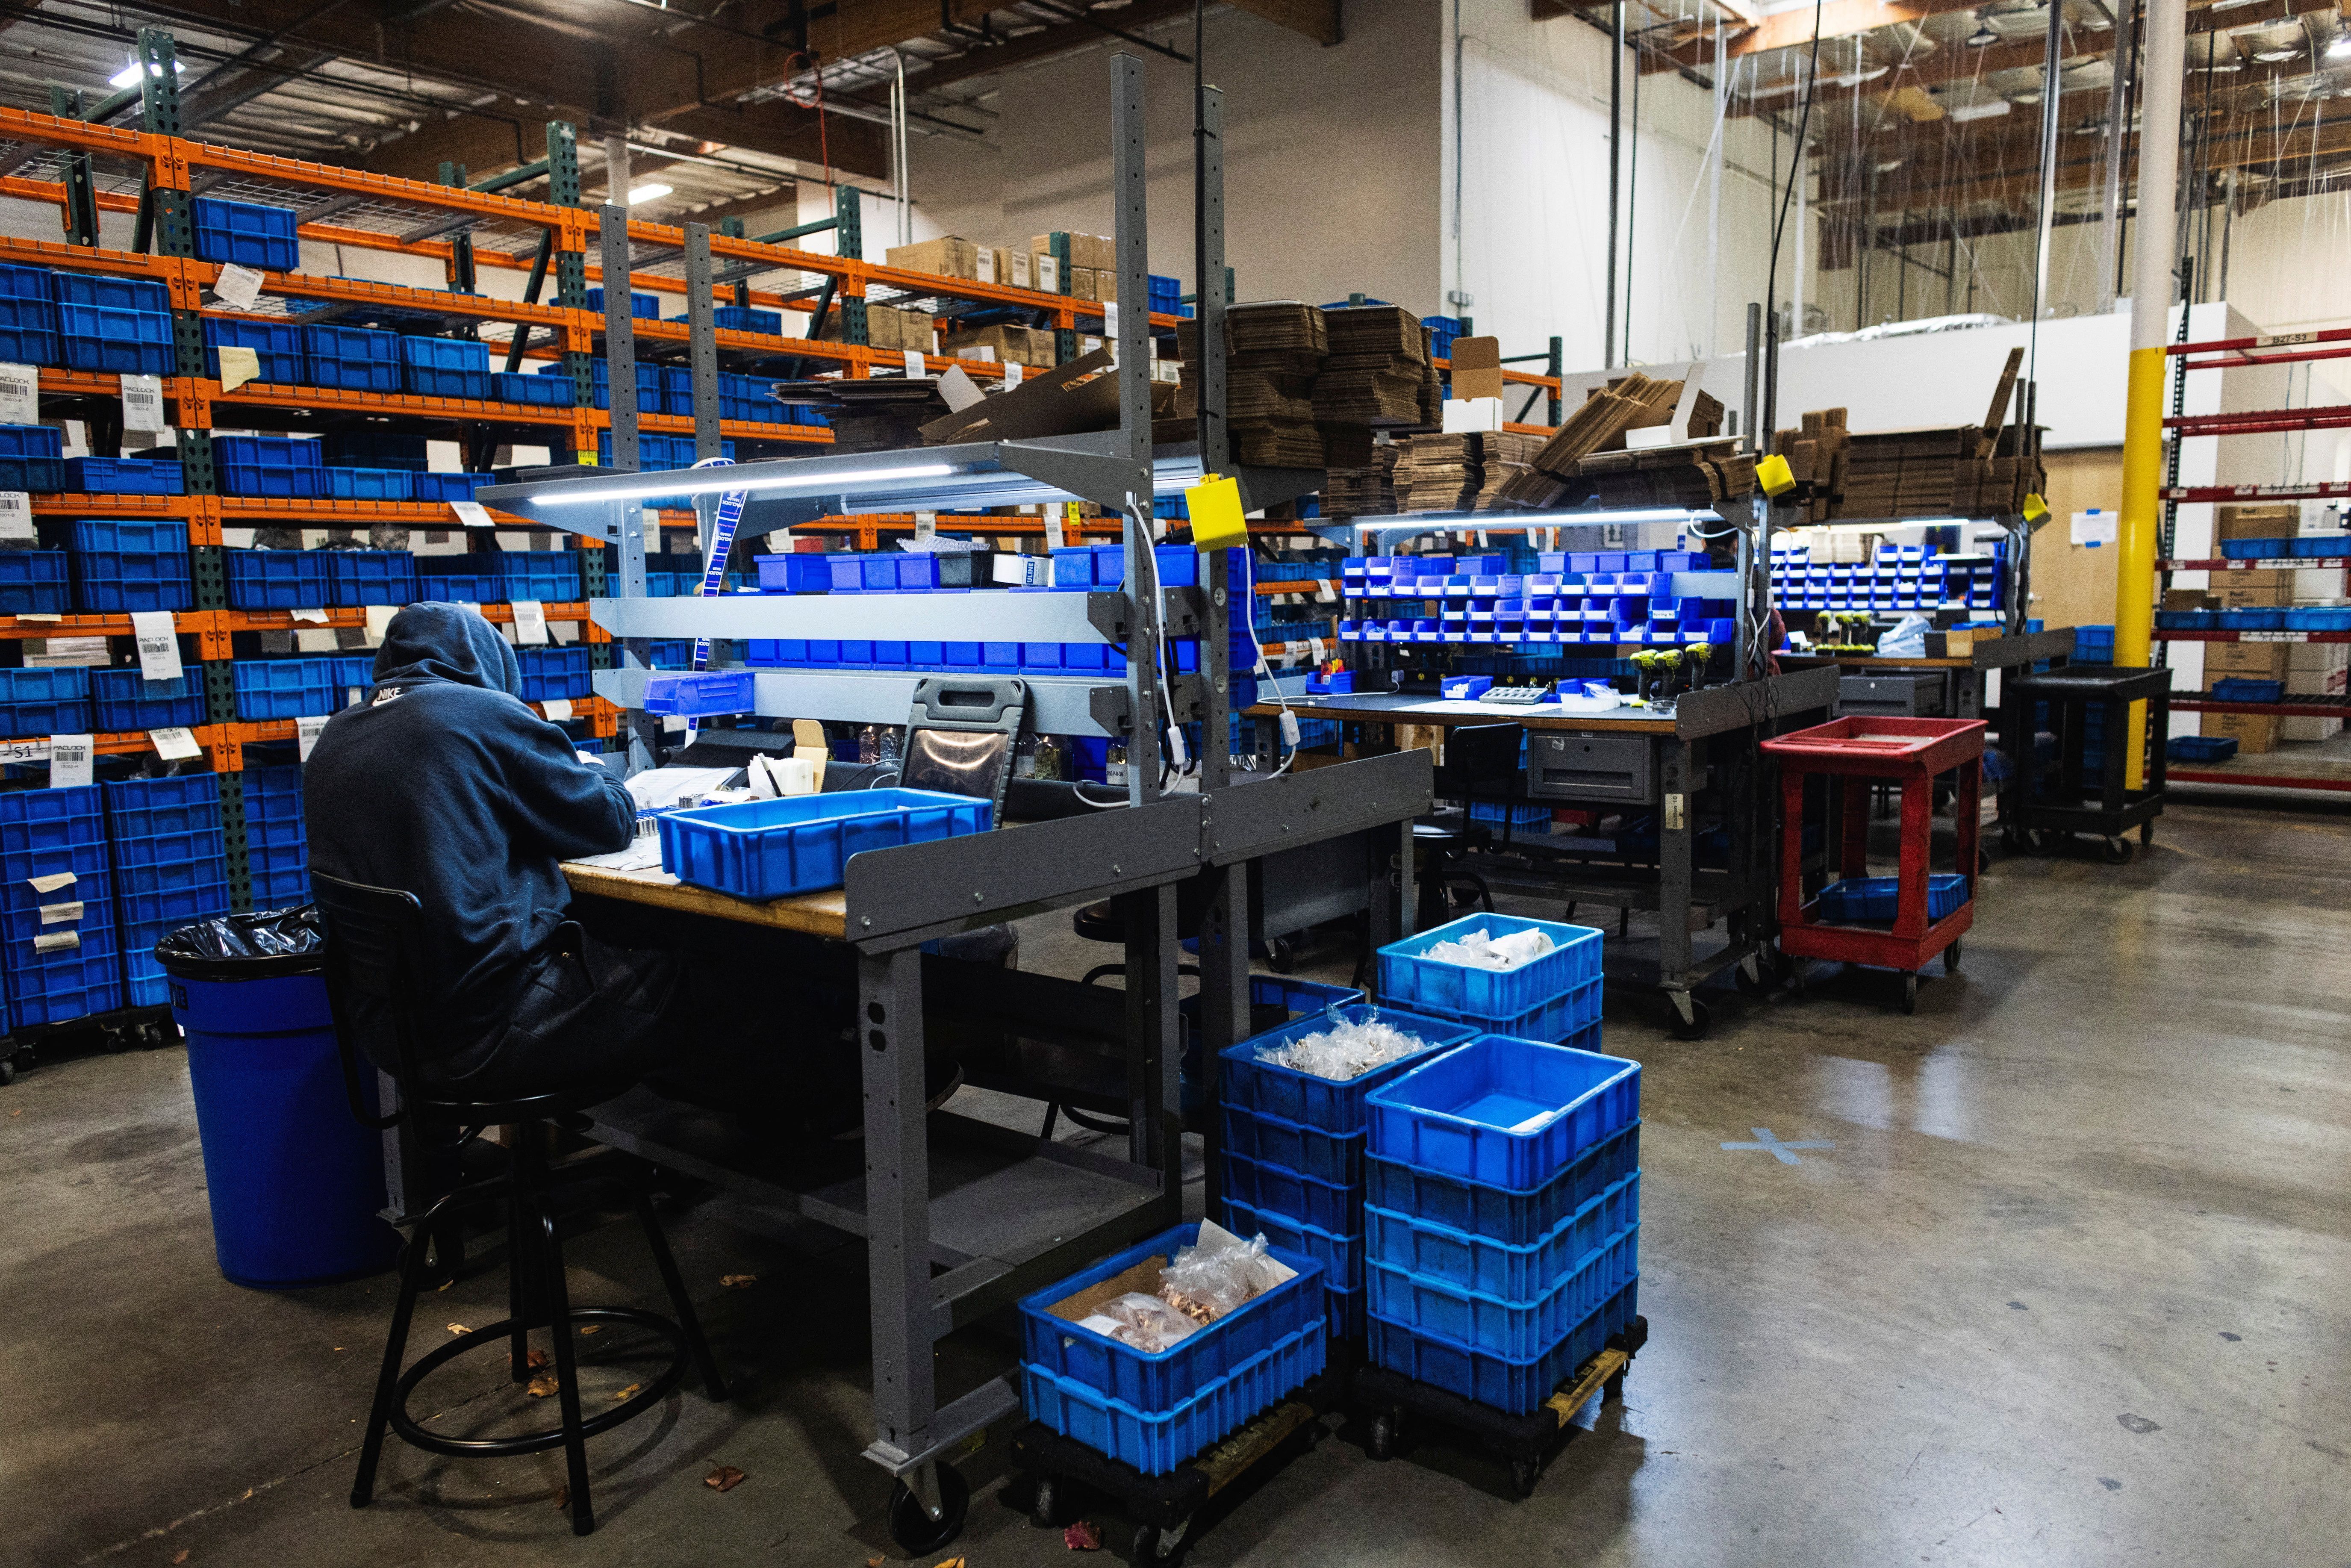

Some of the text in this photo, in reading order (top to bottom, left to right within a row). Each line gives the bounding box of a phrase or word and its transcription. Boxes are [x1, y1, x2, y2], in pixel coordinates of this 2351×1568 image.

[2273, 333, 2307, 344] B27-S3
[0, 376, 29, 384] ACLOCK
[377, 687, 401, 701] NIKE
[14, 746, 33, 758] S1
